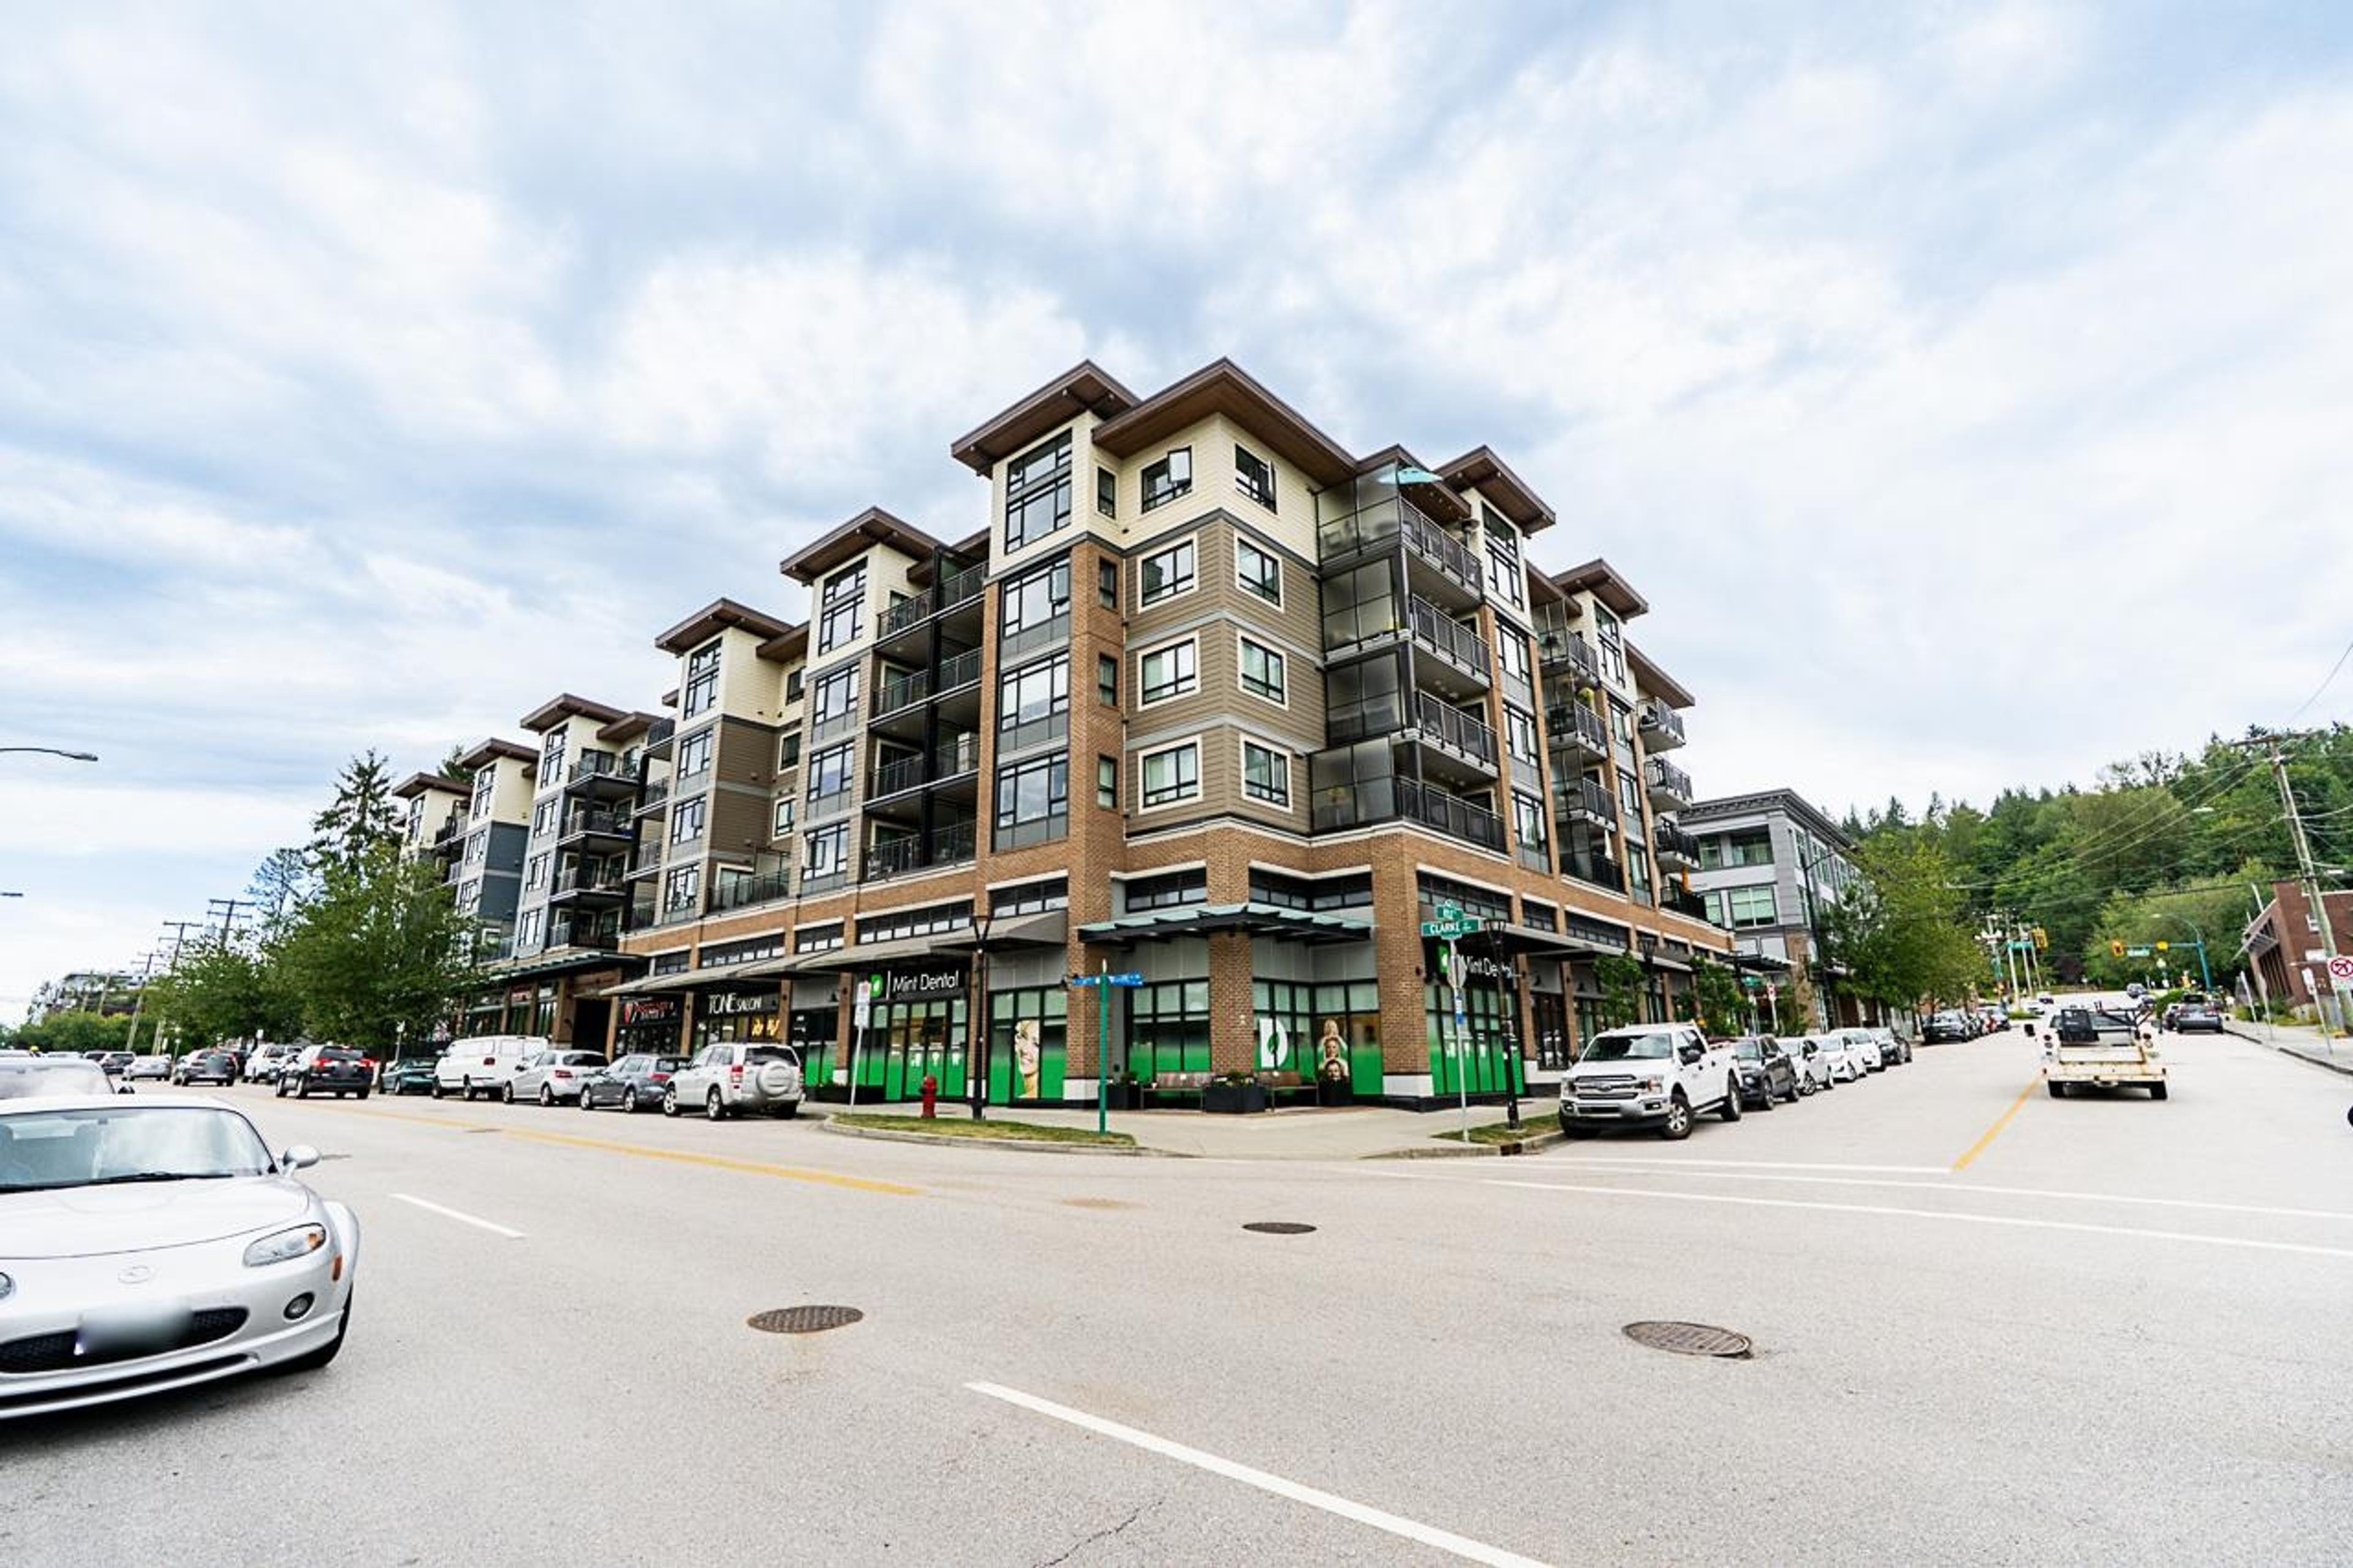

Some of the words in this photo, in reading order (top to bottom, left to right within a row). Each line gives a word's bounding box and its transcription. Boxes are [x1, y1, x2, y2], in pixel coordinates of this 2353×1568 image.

[1430, 920, 1460, 935] CLARKE
[1483, 957, 1515, 979] Detal
[892, 975, 918, 993] Mint
[920, 969, 959, 990] Dental
[708, 992, 737, 1014] TONE
